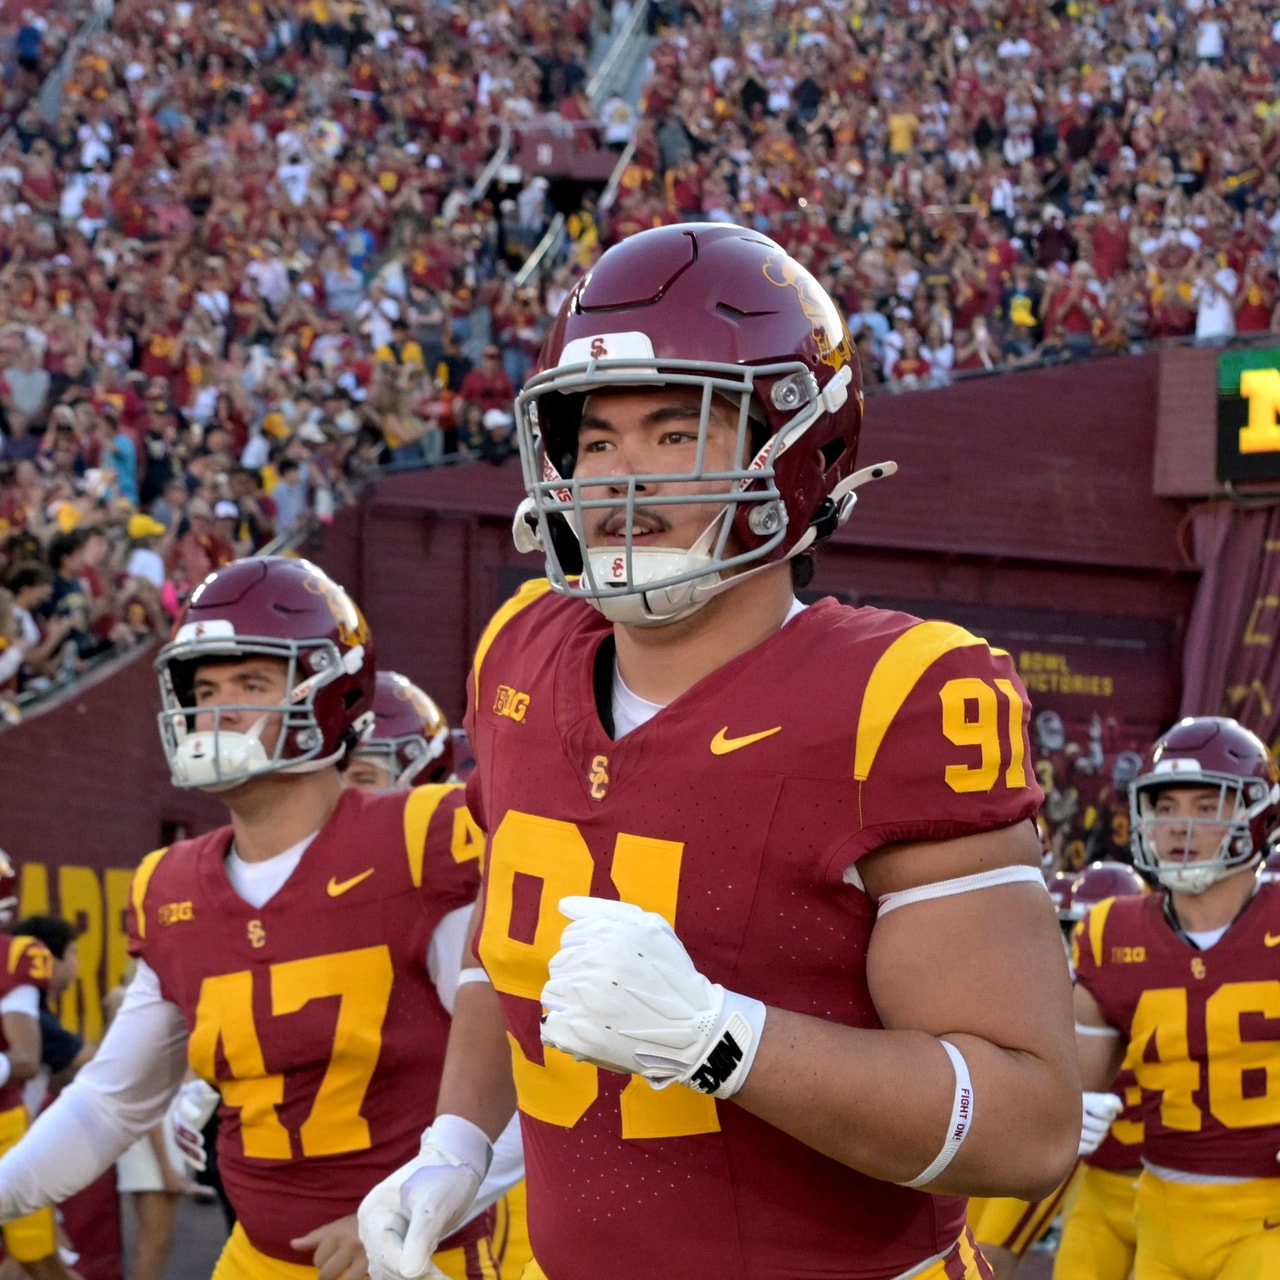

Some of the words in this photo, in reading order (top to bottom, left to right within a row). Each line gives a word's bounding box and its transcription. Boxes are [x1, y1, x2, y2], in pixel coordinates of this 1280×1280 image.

[1020, 651, 1069, 676] BOWL
[938, 677, 1027, 793] 91
[589, 755, 609, 799] SC
[247, 920, 266, 947] SC
[478, 809, 722, 1139] 91
[1190, 957, 1206, 980] SC
[188, 944, 394, 1159] 47
[690, 1030, 744, 1095] NIKE
[960, 1088, 970, 1120] FIGHT
[952, 1123, 966, 1141] ON!
